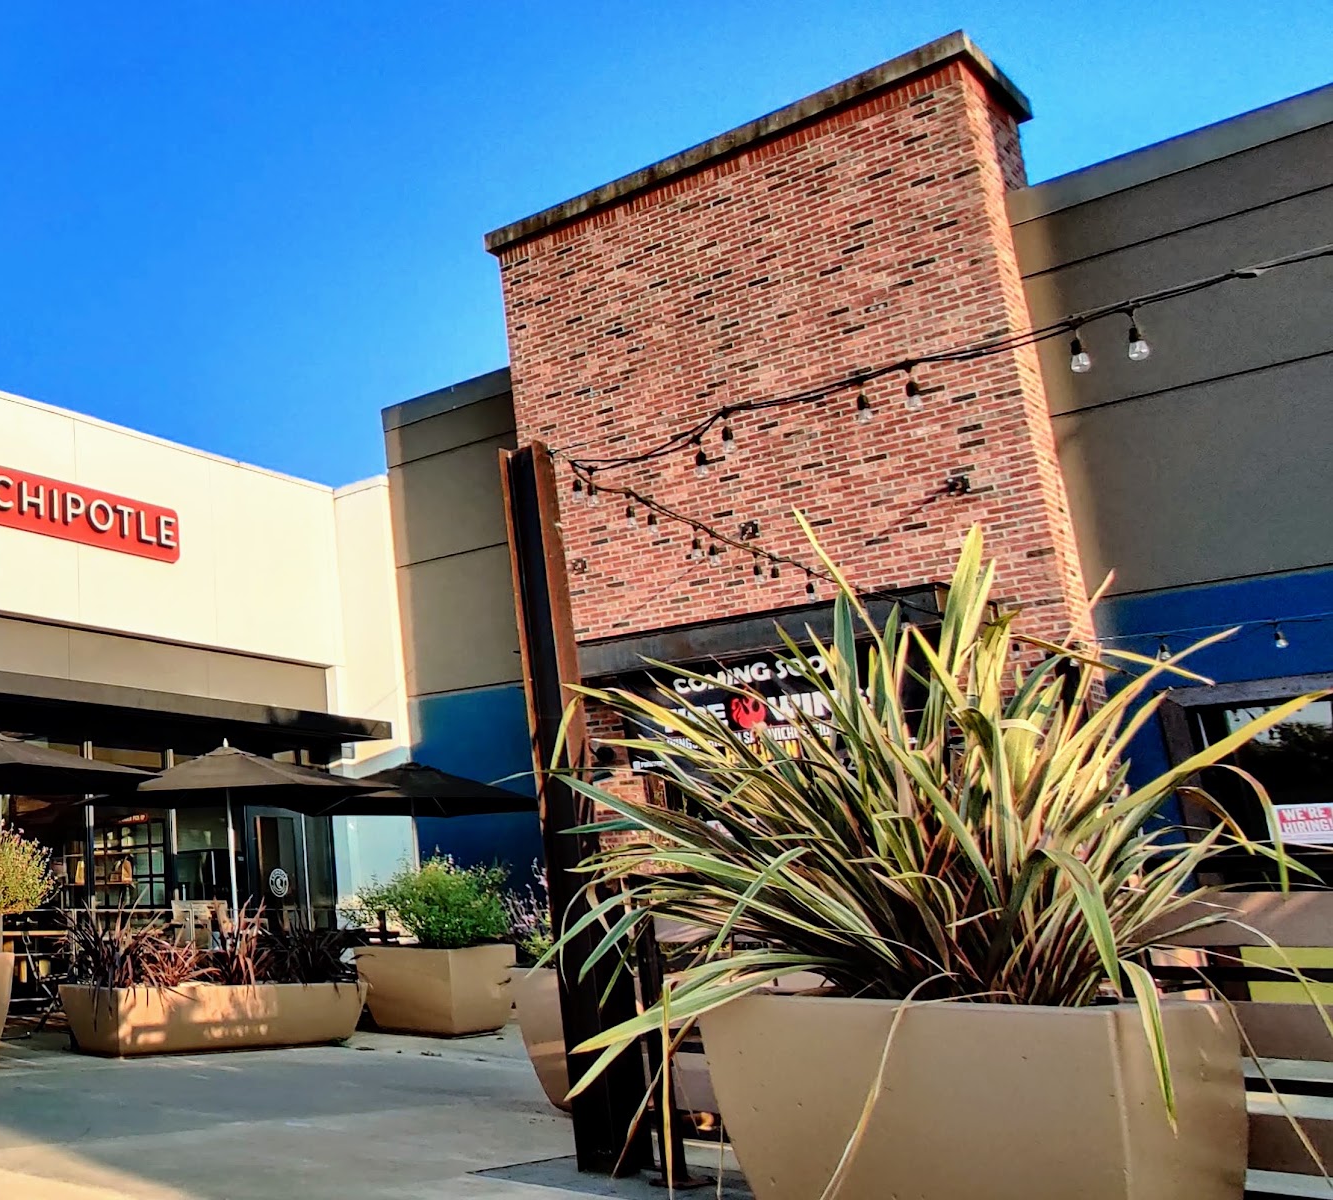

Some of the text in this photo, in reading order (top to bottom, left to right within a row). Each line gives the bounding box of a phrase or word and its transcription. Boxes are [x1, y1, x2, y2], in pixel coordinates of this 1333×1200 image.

[673, 655, 831, 694] COMING SOO
[1281, 807, 1328, 822] WE'RE
